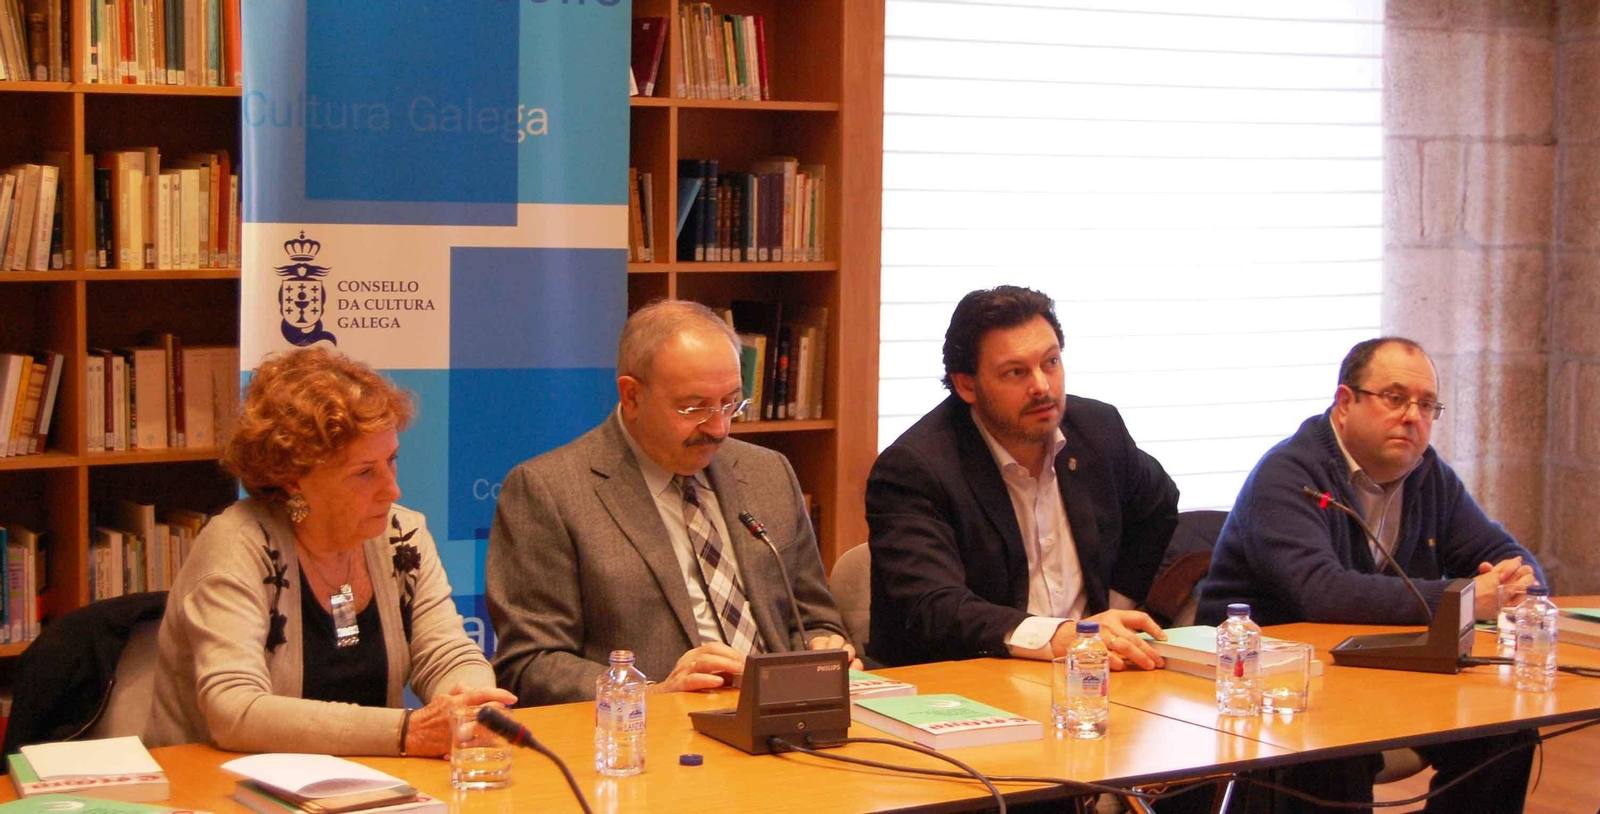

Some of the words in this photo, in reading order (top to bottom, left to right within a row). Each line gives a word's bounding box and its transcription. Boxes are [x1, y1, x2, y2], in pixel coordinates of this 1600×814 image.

[408, 95, 549, 143] Galega
[337, 280, 419, 293] CONSELLO
[337, 299, 360, 311] DA
[364, 299, 435, 311] CULTURA
[337, 317, 401, 329] GALEGA
[816, 664, 841, 672] PHILIPS
